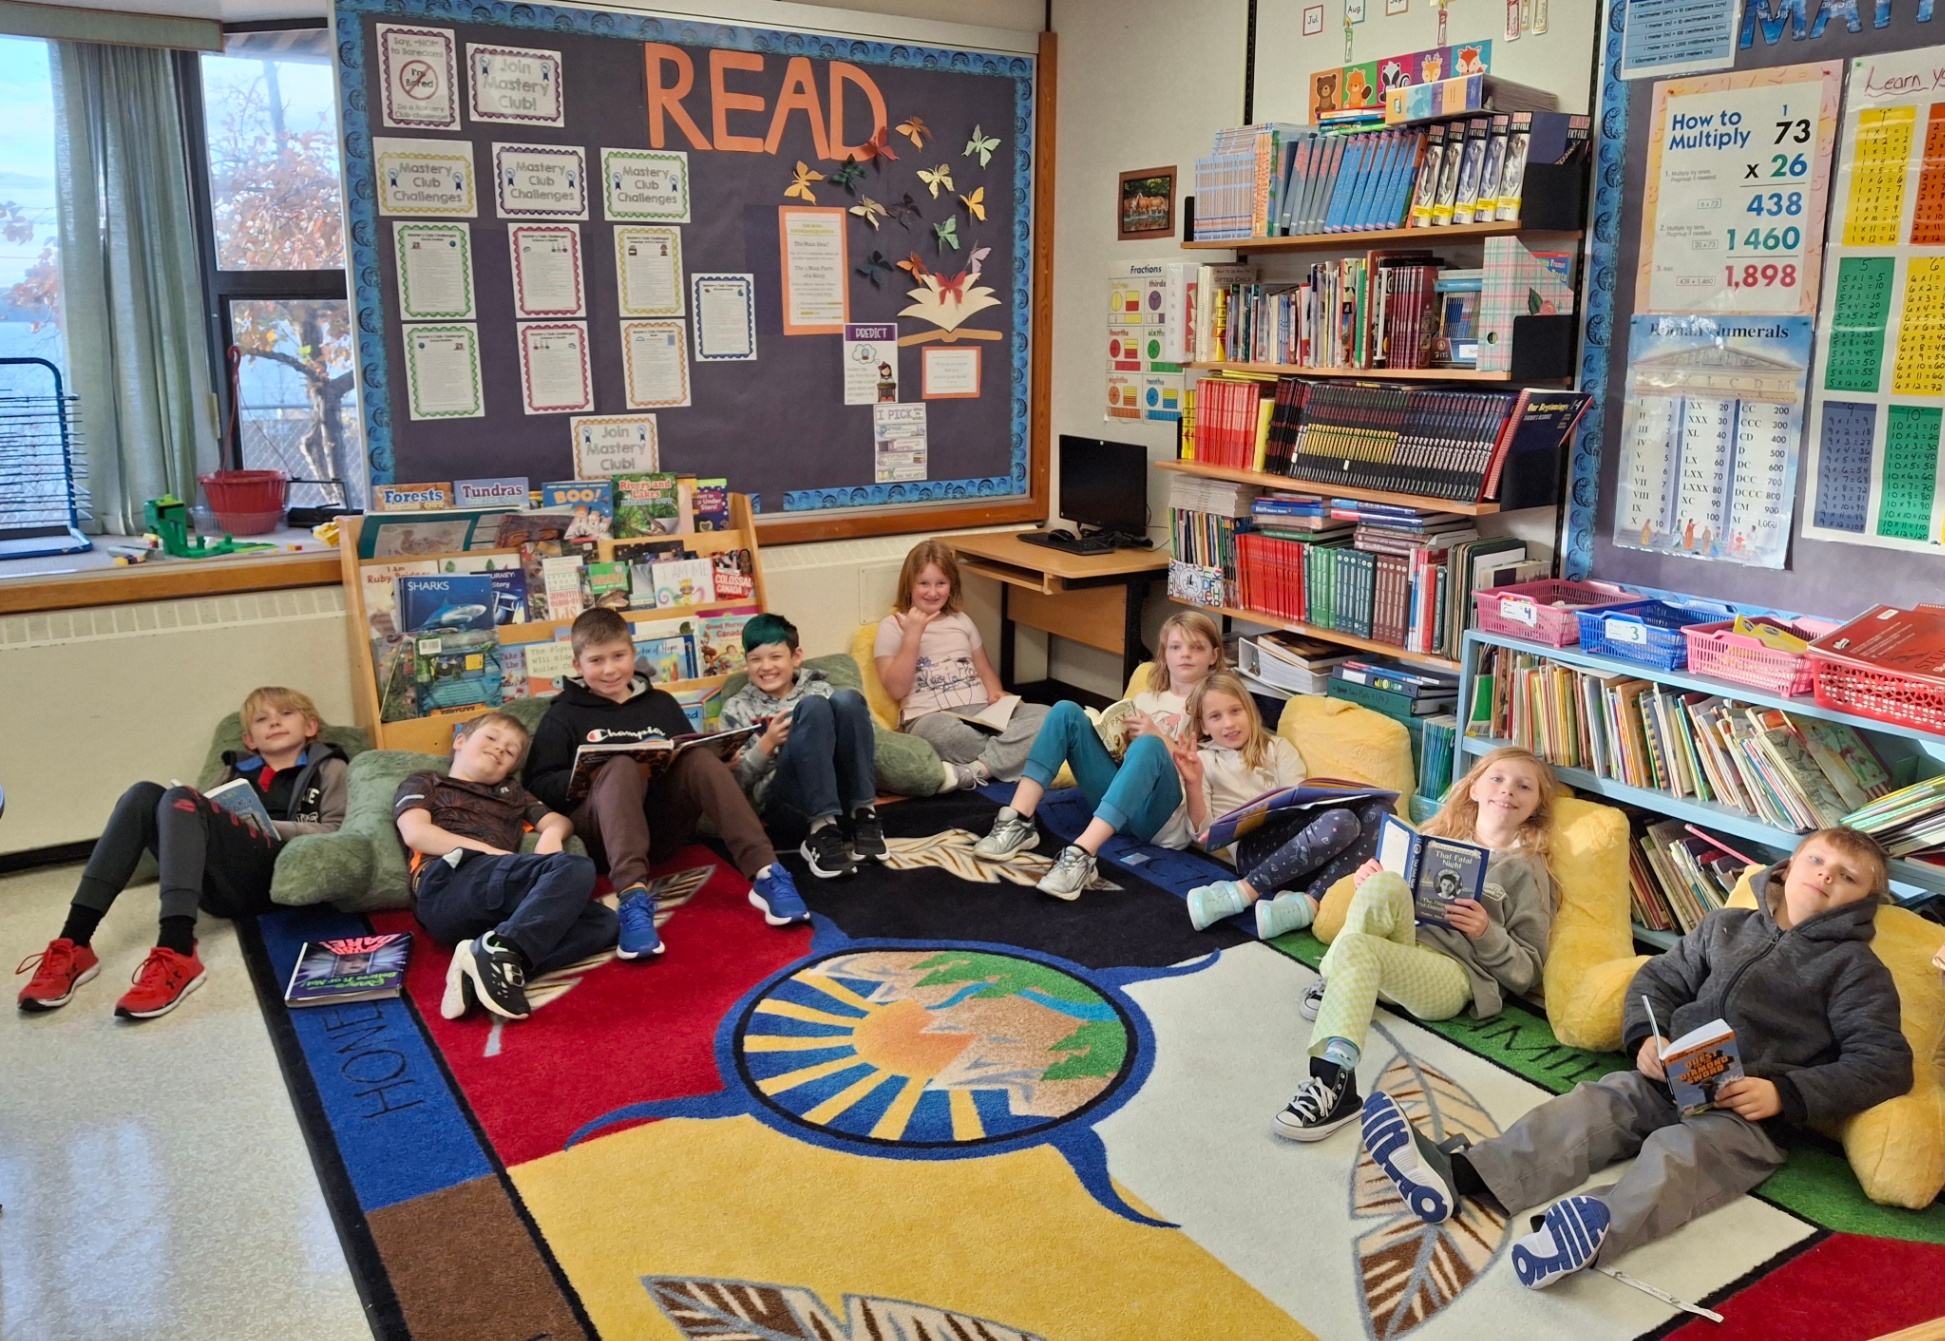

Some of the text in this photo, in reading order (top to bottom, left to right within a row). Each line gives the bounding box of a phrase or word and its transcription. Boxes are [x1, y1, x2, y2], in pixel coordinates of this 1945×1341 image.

[501, 58, 531, 74] Join
[406, 79, 433, 88] Bored
[1865, 66, 1921, 91] Learn
[483, 76, 549, 96] Mastery
[500, 95, 537, 111] Club!
[645, 42, 887, 161] READ
[1783, 105, 1787, 116] 1
[1672, 110, 1742, 131] How to
[1774, 119, 1811, 144] 73
[1669, 128, 1751, 150] Multiply
[400, 162, 452, 178] Mastery
[516, 161, 565, 178] Mastery
[1770, 153, 1808, 177] 26
[529, 175, 554, 186] Club
[623, 166, 669, 183] Mastery
[413, 176, 440, 188] Club
[635, 179, 659, 191] Club
[393, 191, 462, 204] Challenges
[511, 188, 574, 202] Challenges
[617, 192, 677, 205] Challenges
[1746, 192, 1802, 216] 438
[1130, 265, 1161, 274] Fractions
[1725, 264, 1797, 291] 1,898
[856, 328, 887, 338] PREDICT
[1651, 323, 1703, 337] Roman
[1690, 402, 1728, 412] XX 20
[1742, 405, 1789, 415] CC 200
[877, 410, 884, 420] I
[888, 409, 912, 420] PICK
[1689, 416, 1708, 424] XXX
[1741, 419, 1761, 427] CCC
[1893, 422, 1903, 430] 10
[602, 426, 629, 438] Join
[1717, 431, 1726, 439] 40
[586, 442, 646, 456] Mastery
[1716, 445, 1725, 453] 50
[1770, 450, 1785, 458] 500
[600, 458, 635, 471] Club!
[1715, 459, 1724, 467] 60
[1738, 461, 1783, 472] DC 600
[1684, 470, 1703, 478] LXX
[1736, 475, 1756, 483] DCC
[463, 484, 523, 498] Tundras
[619, 479, 672, 491] Rivers and
[1683, 484, 1708, 492] LXXX
[384, 489, 443, 503] Forests
[553, 489, 602, 504] BOO!
[631, 489, 661, 499] Lakes
[1735, 489, 1762, 498] DCCC
[672, 564, 688, 577] AM
[693, 561, 708, 576] ME
[367, 574, 392, 583] Ruby
[715, 574, 752, 587] COLOSSAL
[407, 581, 449, 591] SHARKS
[716, 584, 749, 595] CANADA
[1523, 607, 1532, 619] 4
[1630, 627, 1640, 641] 3
[533, 665, 558, 673] Roller
[587, 726, 666, 742] Champion
[1435, 850, 1473, 864] That Fatal
[1442, 859, 1462, 869] Night
[321, 1002, 427, 1119] HOME
[1685, 1050, 1722, 1068] QUEST
[1680, 1056, 1731, 1081] DIAMOND
[1687, 1064, 1727, 1085] SWORD
